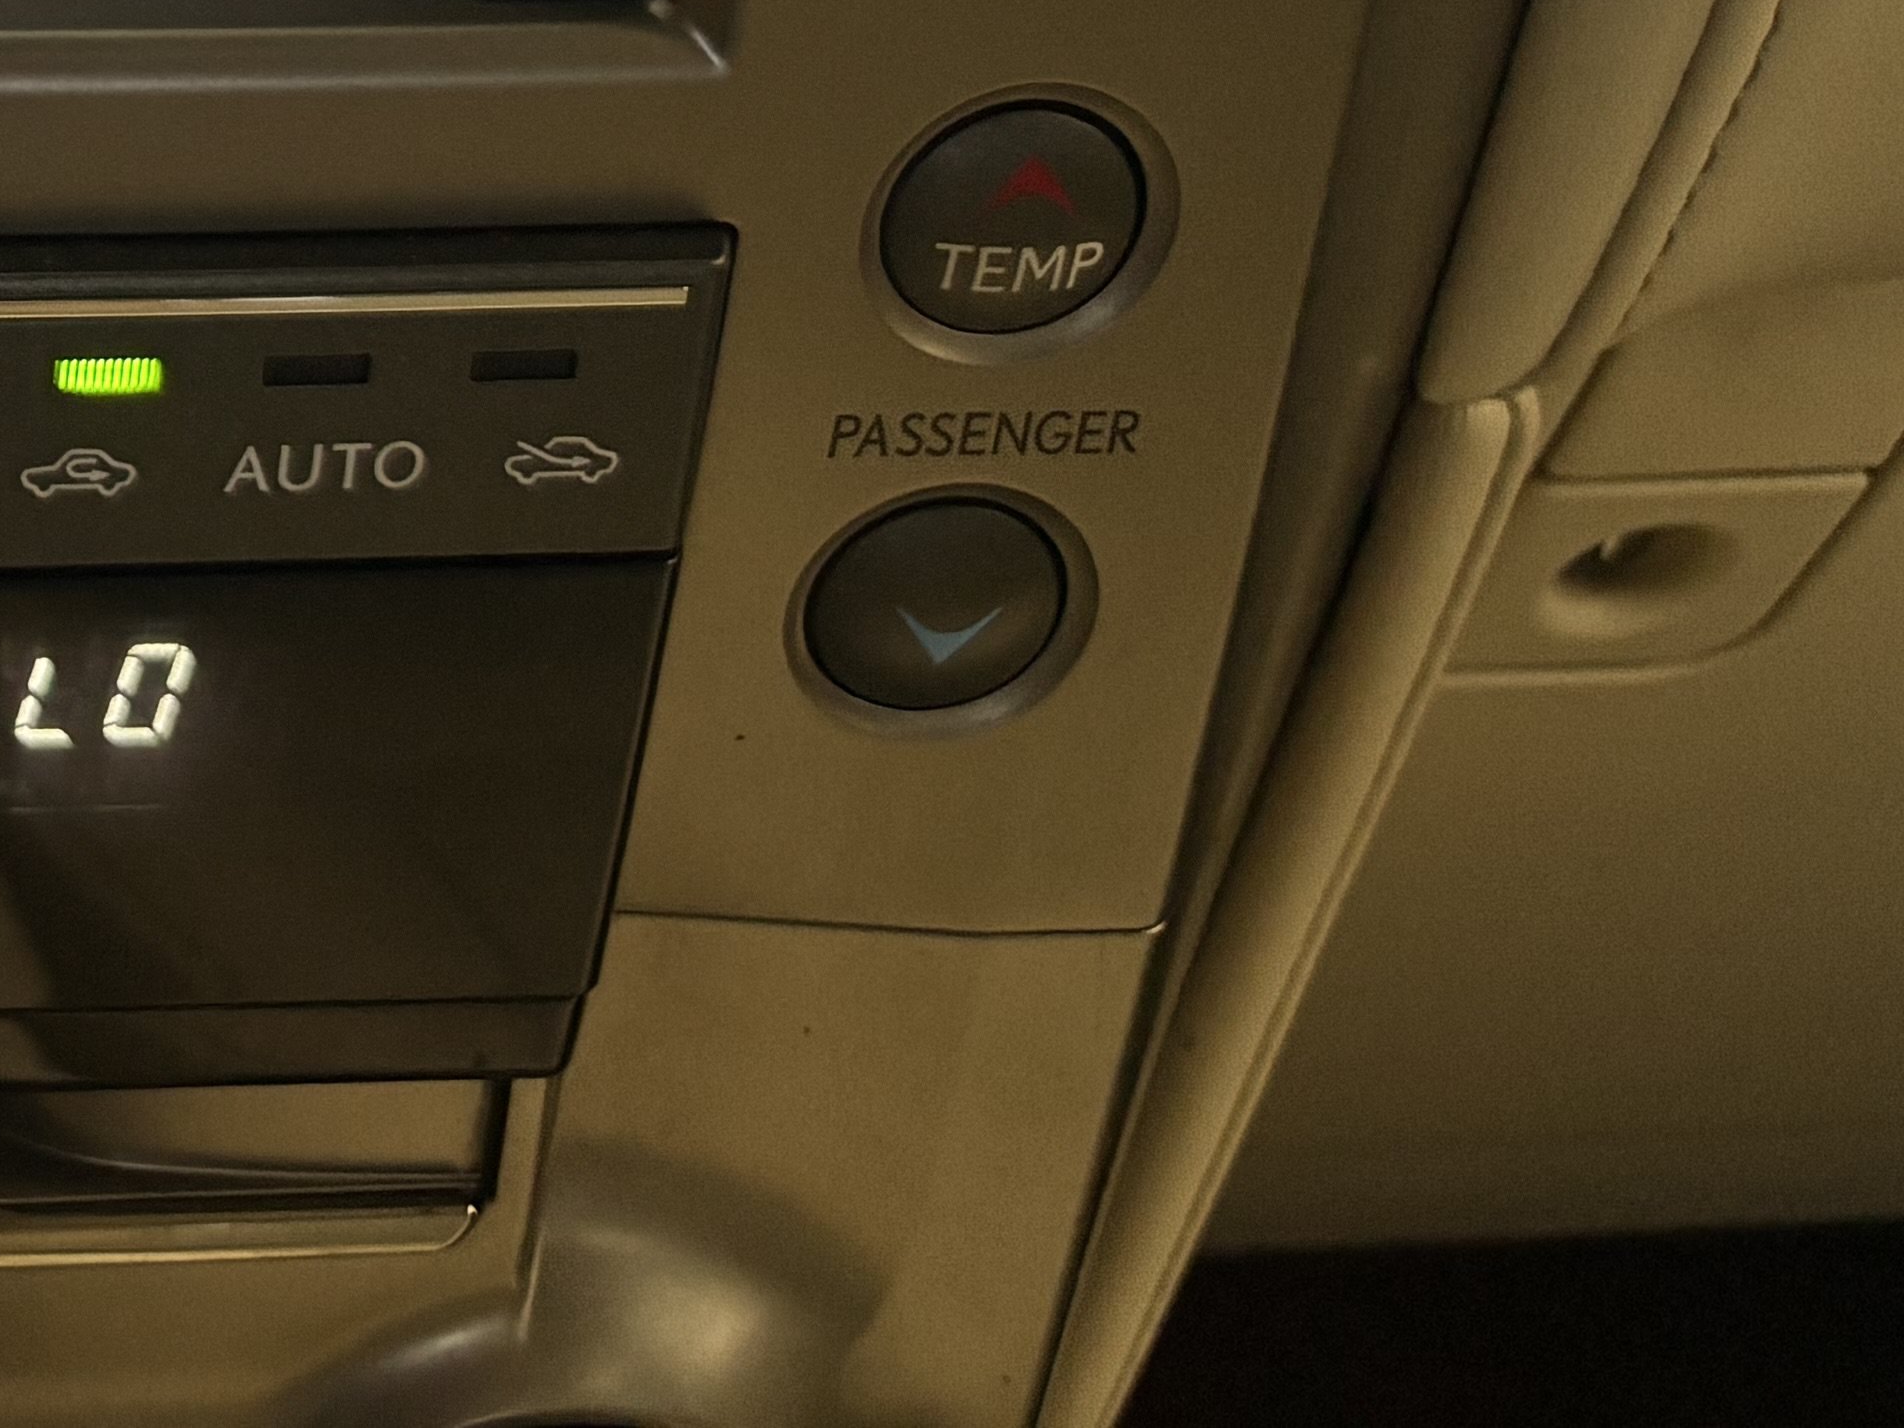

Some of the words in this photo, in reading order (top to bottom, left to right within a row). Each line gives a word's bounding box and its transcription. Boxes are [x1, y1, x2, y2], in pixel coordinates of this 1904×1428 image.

[935, 241, 1104, 292] TEMP
[827, 411, 1142, 458] PASSENGER
[224, 440, 428, 492] AUTO
